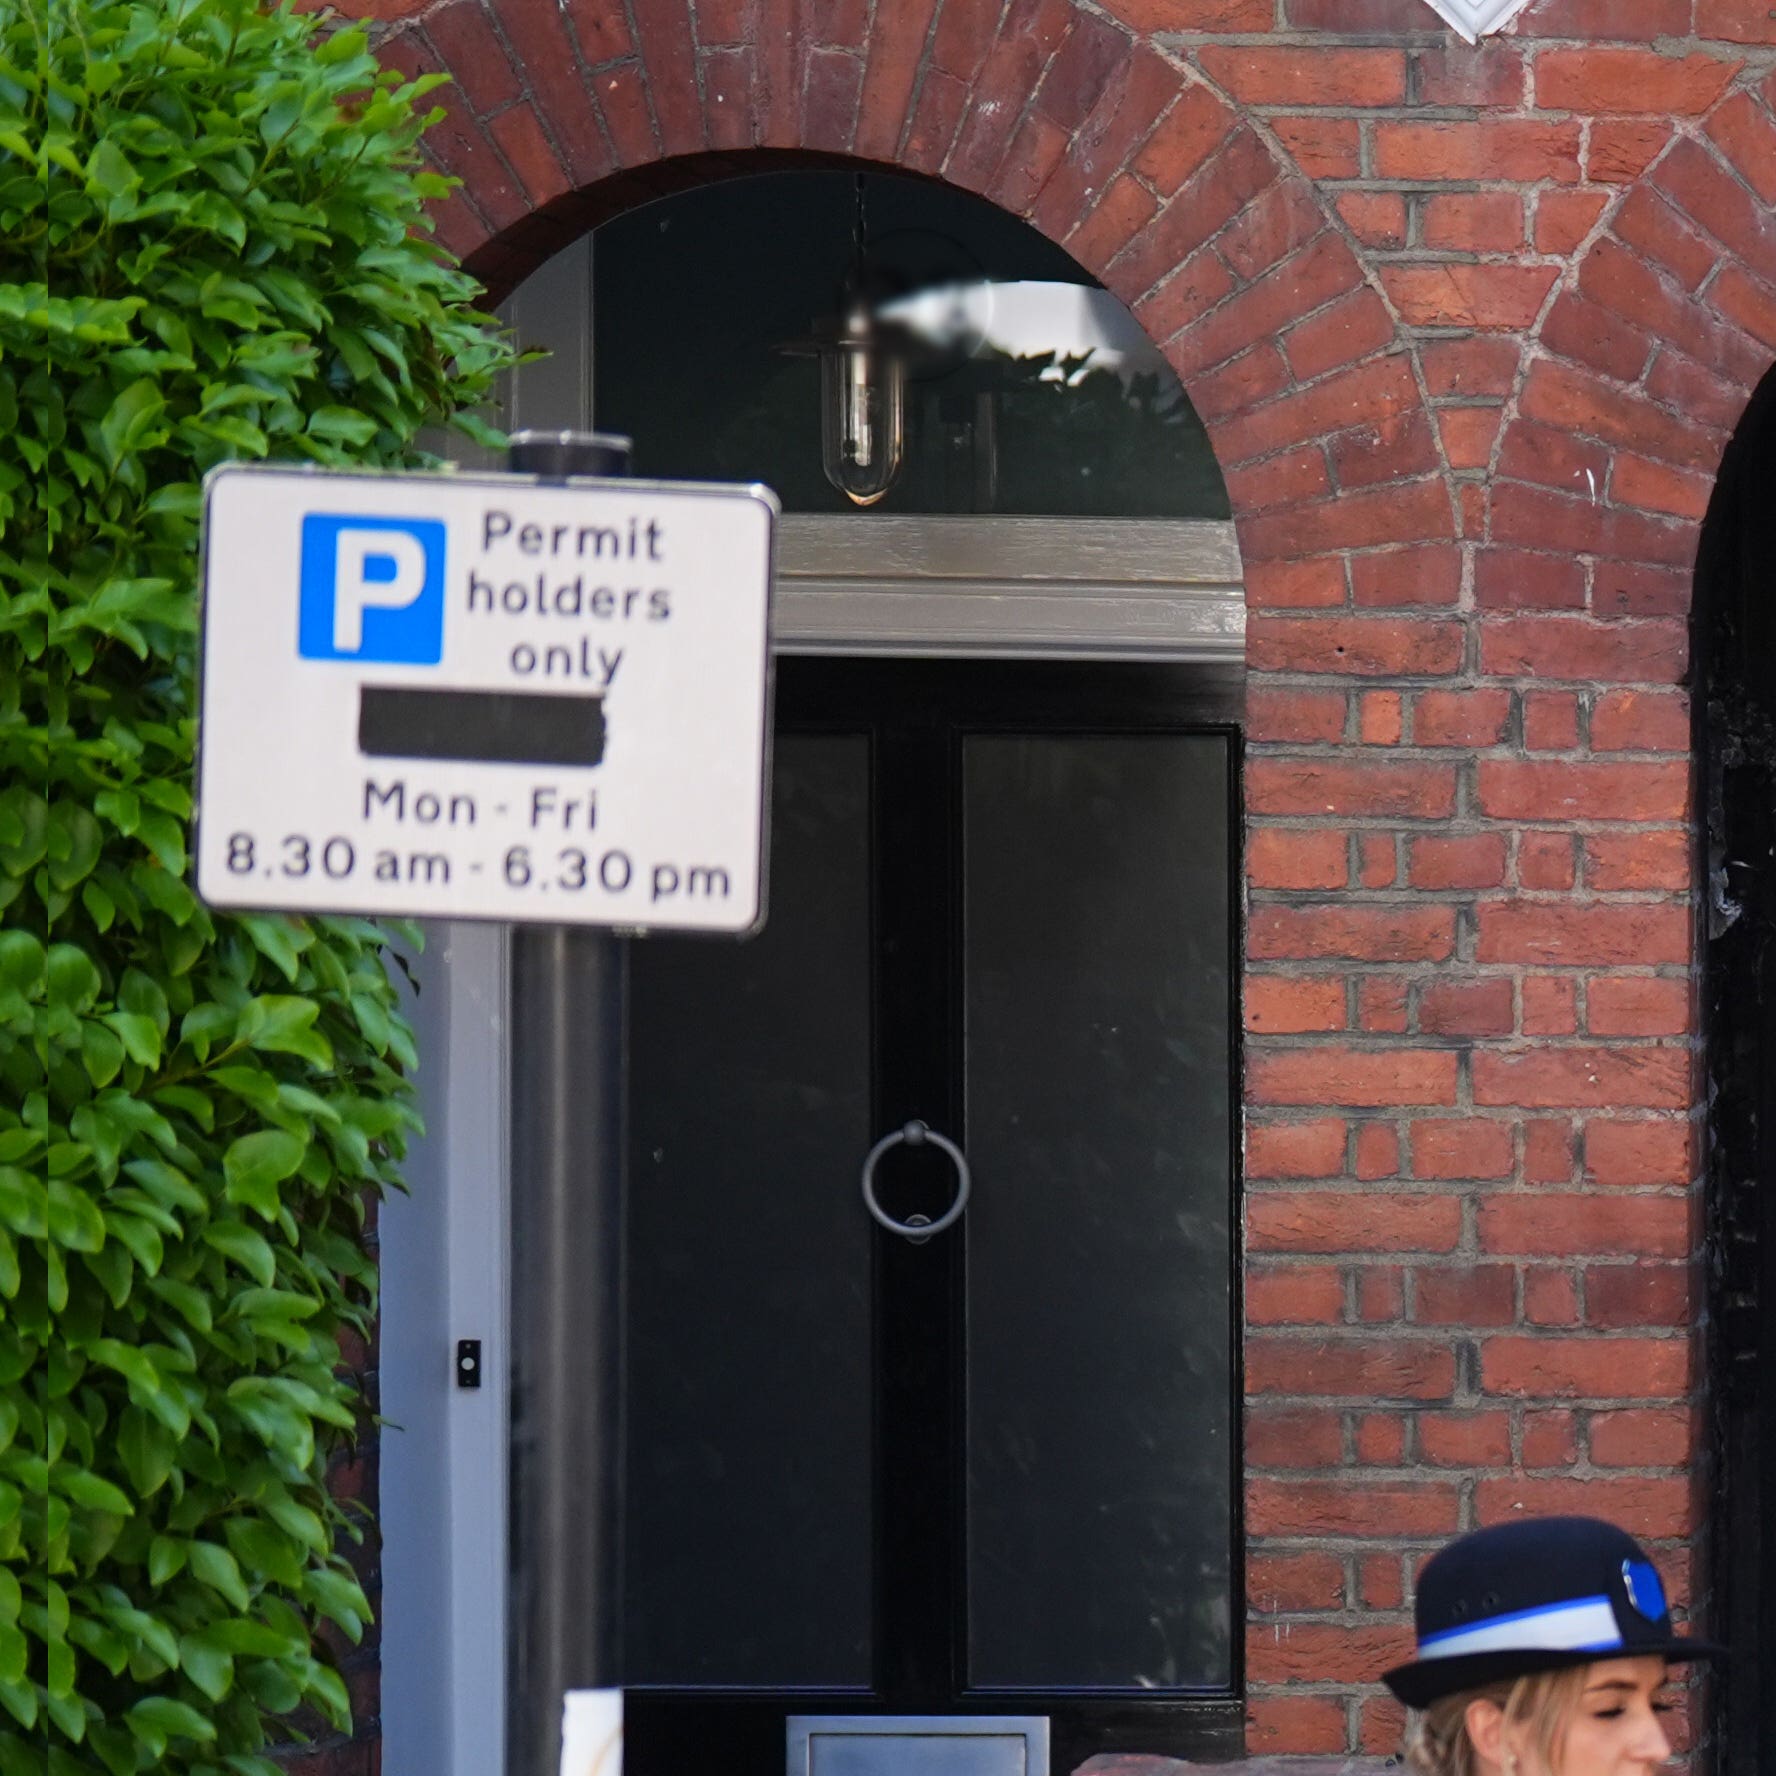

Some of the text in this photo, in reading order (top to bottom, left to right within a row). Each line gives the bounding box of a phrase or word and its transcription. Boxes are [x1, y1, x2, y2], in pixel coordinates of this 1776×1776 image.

[482, 509, 662, 562] Permit
[332, 528, 426, 653] P
[466, 570, 672, 621] holders
[509, 636, 623, 687] only
[361, 779, 477, 825] Mon
[530, 787, 598, 832] Fri
[224, 831, 356, 879] 8.30
[374, 852, 450, 885] am
[502, 846, 633, 893] 6.30
[650, 863, 732, 903] pm
